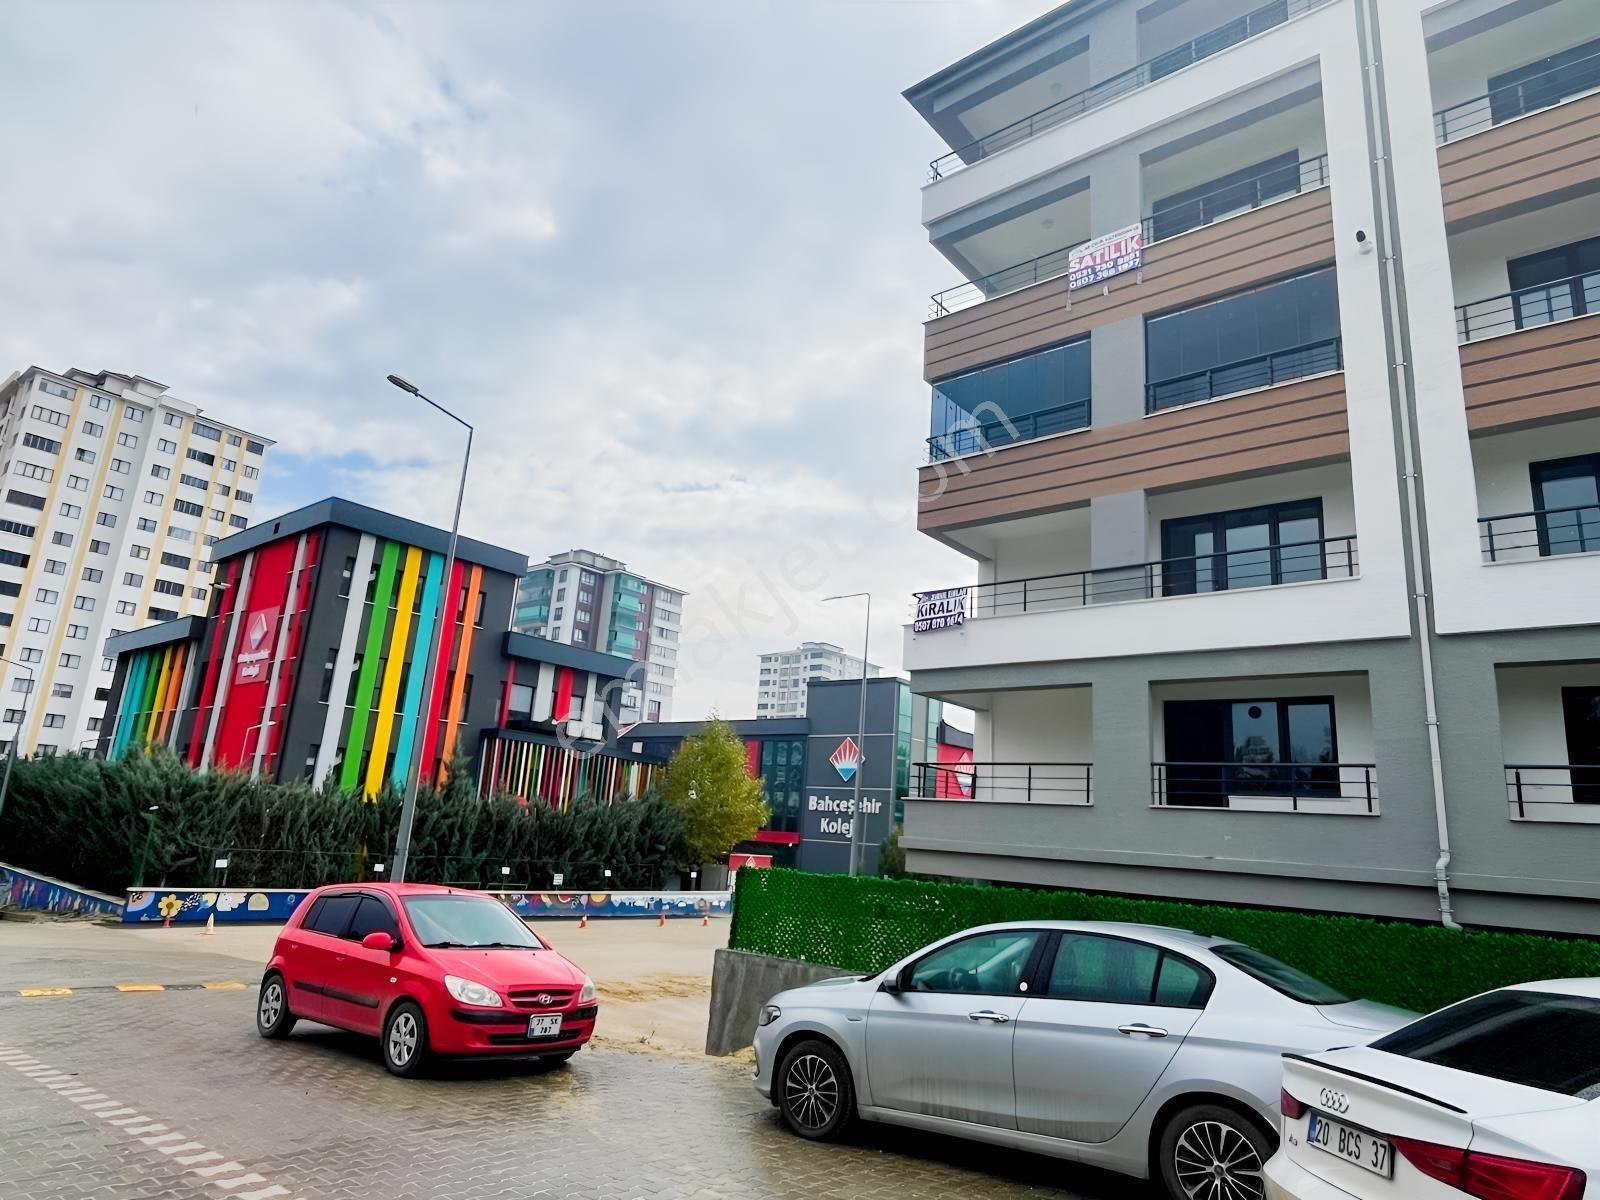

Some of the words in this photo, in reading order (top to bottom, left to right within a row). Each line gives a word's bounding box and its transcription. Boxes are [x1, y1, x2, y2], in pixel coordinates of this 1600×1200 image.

[1069, 234, 1141, 272] SATILIK
[820, 818, 853, 838] Kolej
[1315, 1119, 1330, 1146] 20
[1339, 1127, 1362, 1160] BCS
[1371, 1140, 1387, 1171] 37
